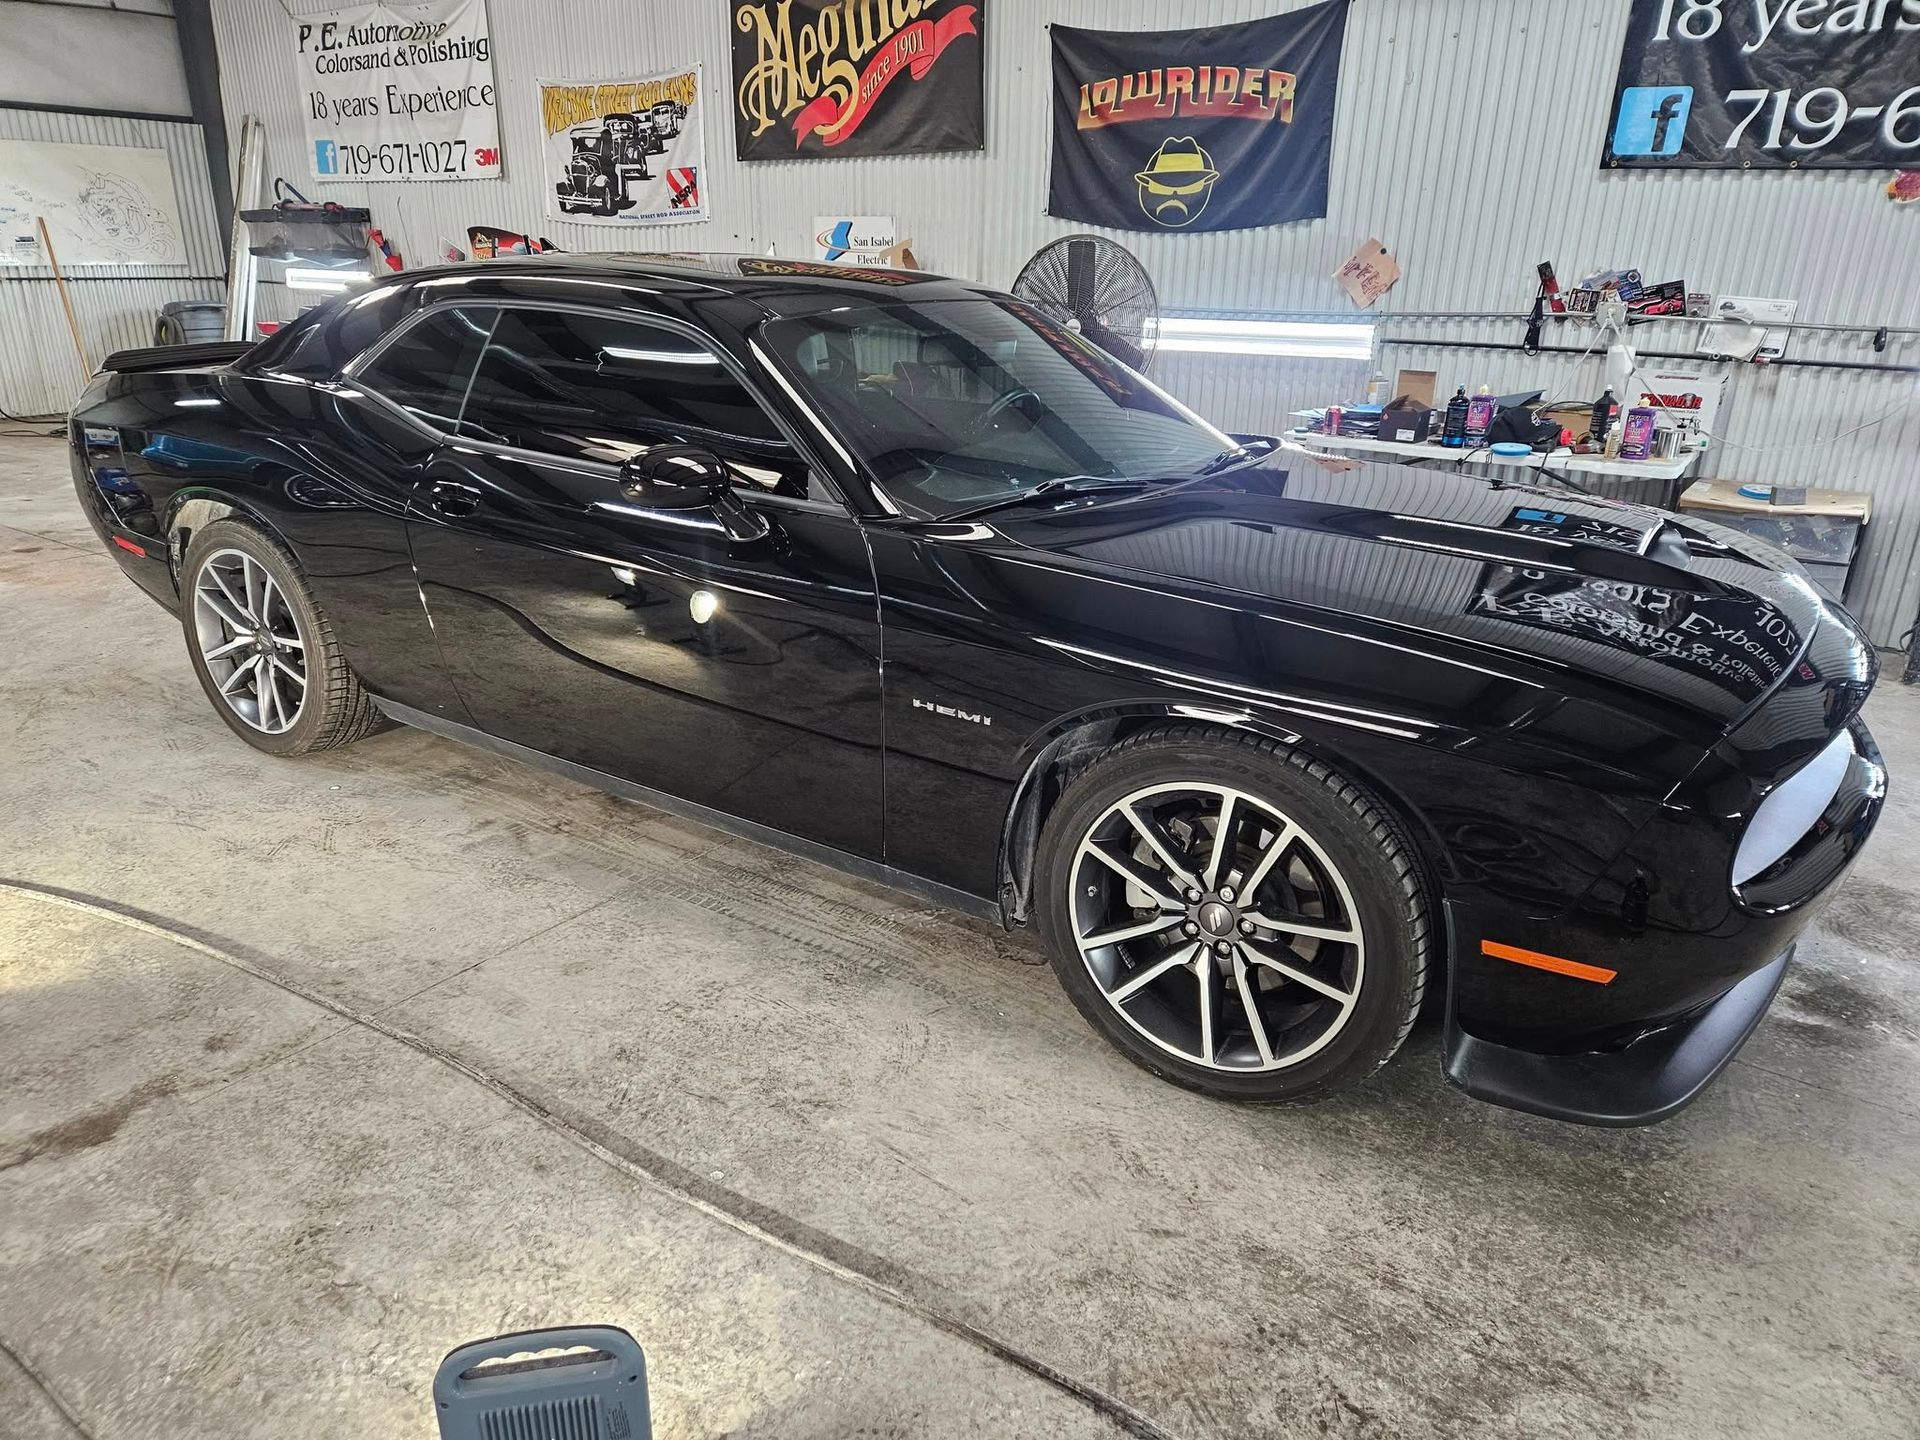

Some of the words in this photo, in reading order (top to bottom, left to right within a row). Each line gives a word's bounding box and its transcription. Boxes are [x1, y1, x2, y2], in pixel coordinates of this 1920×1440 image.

[298, 22, 343, 53] P.E.
[346, 21, 448, 48] Automotive
[1652, 0, 1723, 41] 18
[315, 47, 391, 74] Colorsand
[393, 48, 409, 68] &
[408, 36, 489, 66] Polishing
[861, 54, 891, 105] since
[894, 28, 926, 64] 1901
[310, 91, 328, 119] 18
[332, 95, 379, 126] years
[385, 84, 495, 120] Experience
[542, 84, 596, 139] WELCOME
[593, 83, 637, 118] STREET
[635, 80, 661, 112] ROD
[1077, 65, 1297, 130] LOWRIDER
[1725, 87, 1920, 149] 719-6
[339, 140, 467, 175] 719-671-1027
[474, 148, 500, 167] 3M
[670, 180, 698, 209] NSRA
[669, 209, 701, 217] ASSOCIATION
[853, 236, 869, 247] San
[871, 236, 894, 247] Isabel
[912, 698, 992, 726] HEMI
